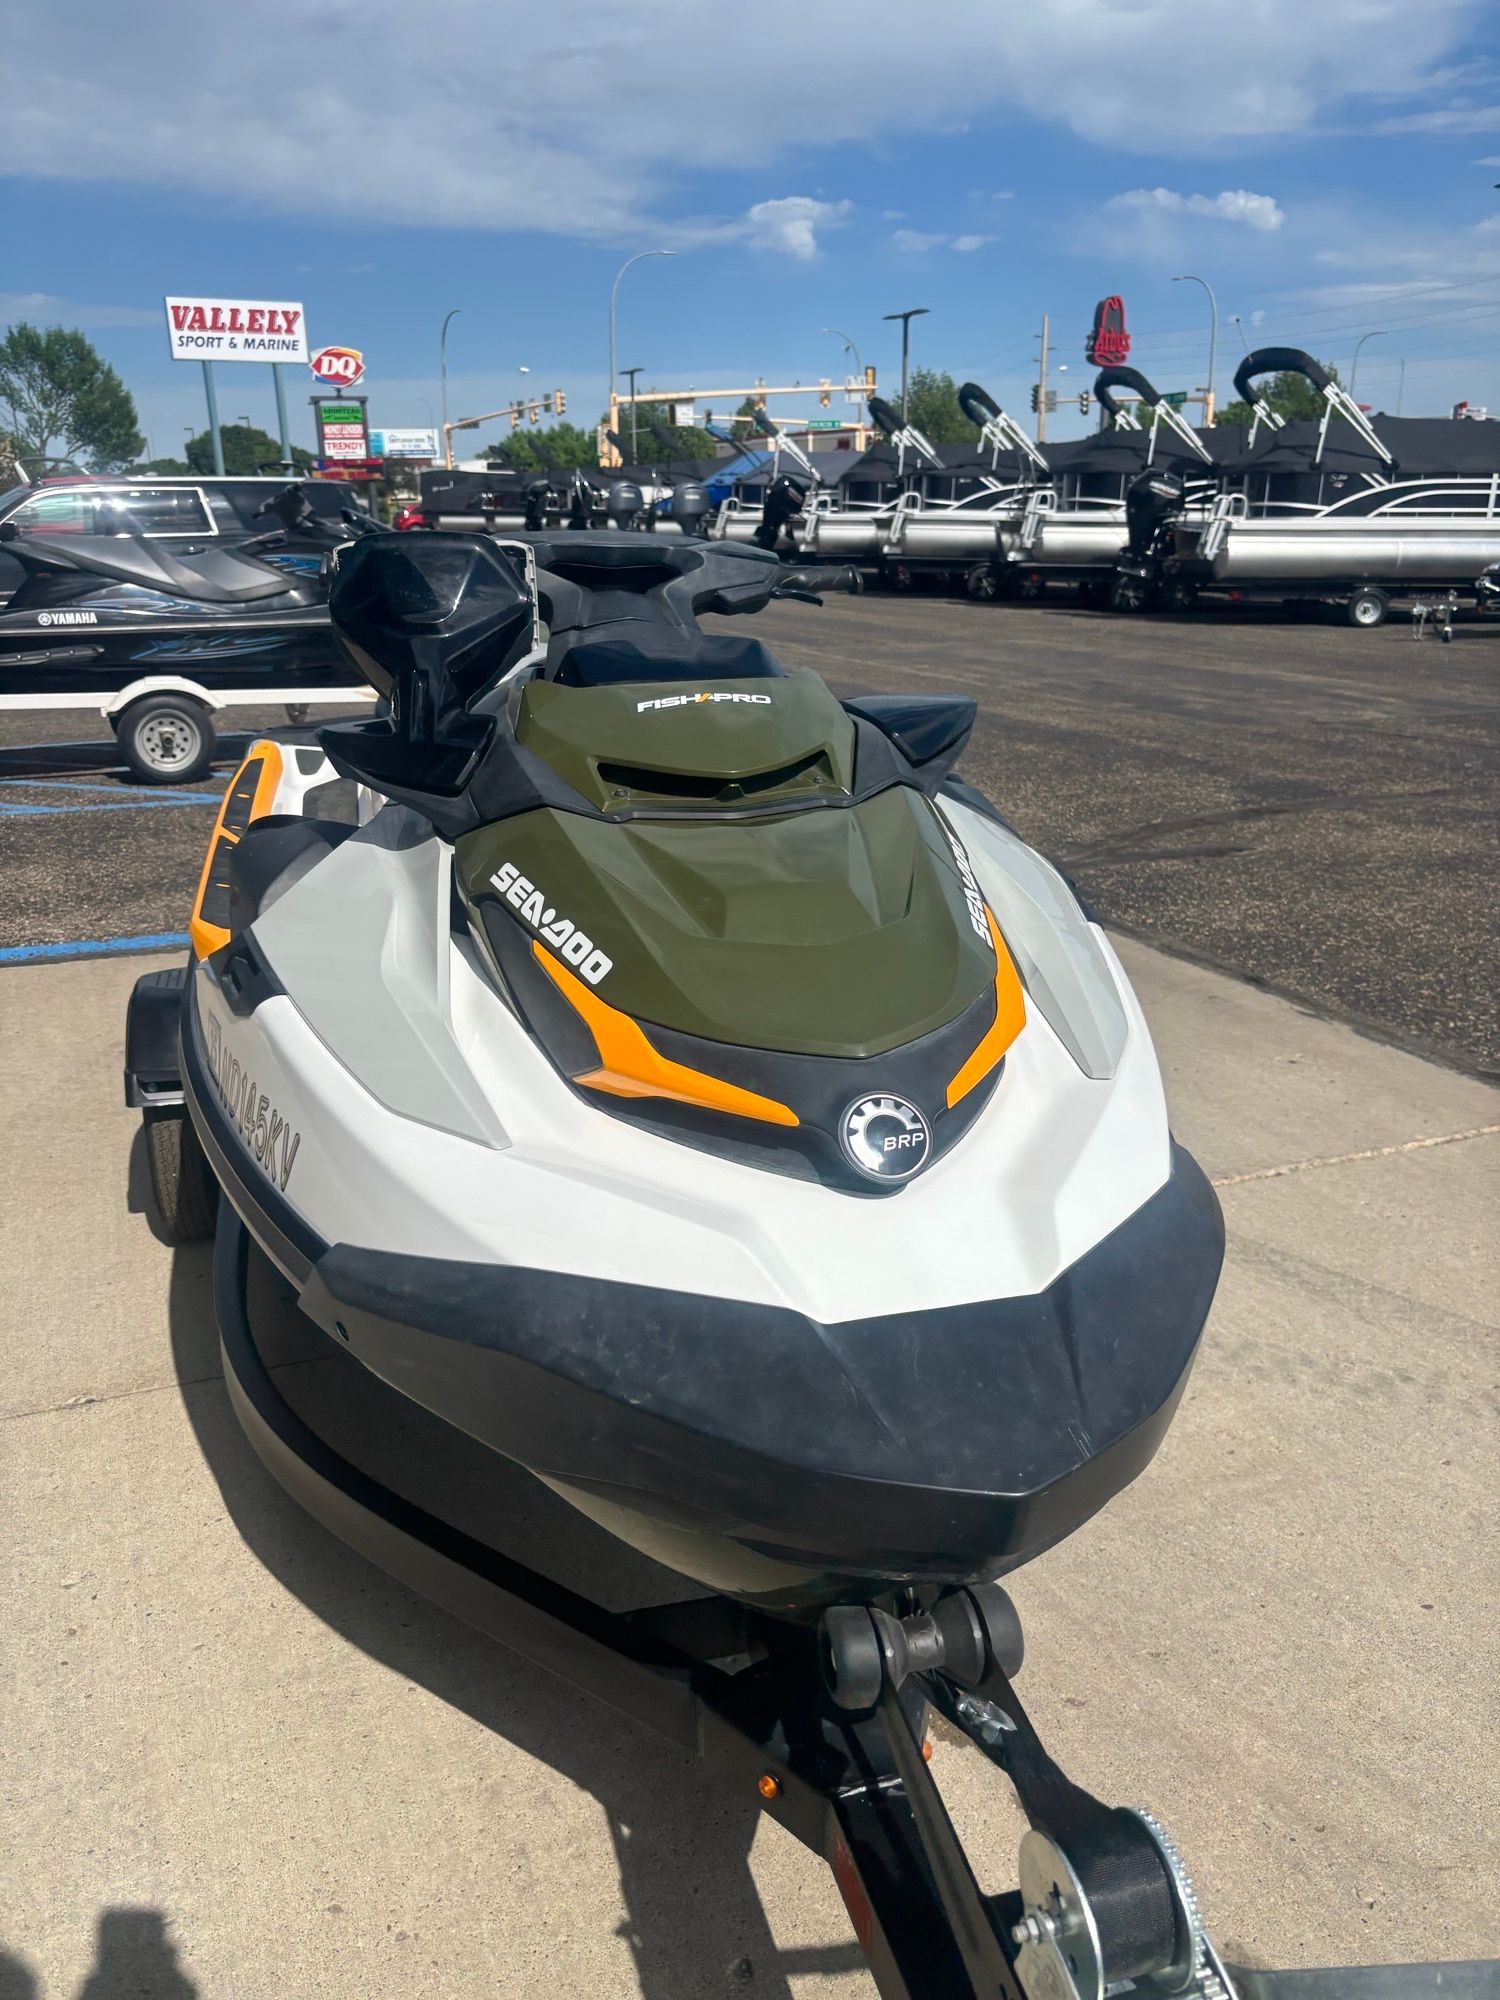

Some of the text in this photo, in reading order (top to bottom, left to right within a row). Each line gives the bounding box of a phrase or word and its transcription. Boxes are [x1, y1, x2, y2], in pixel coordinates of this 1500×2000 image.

[171, 305, 301, 335] VALLELY
[178, 335, 300, 351] SPORT & MARINE
[320, 355, 357, 378] DQ
[51, 612, 98, 625] YAMAHA
[883, 1132, 925, 1152] BRP
